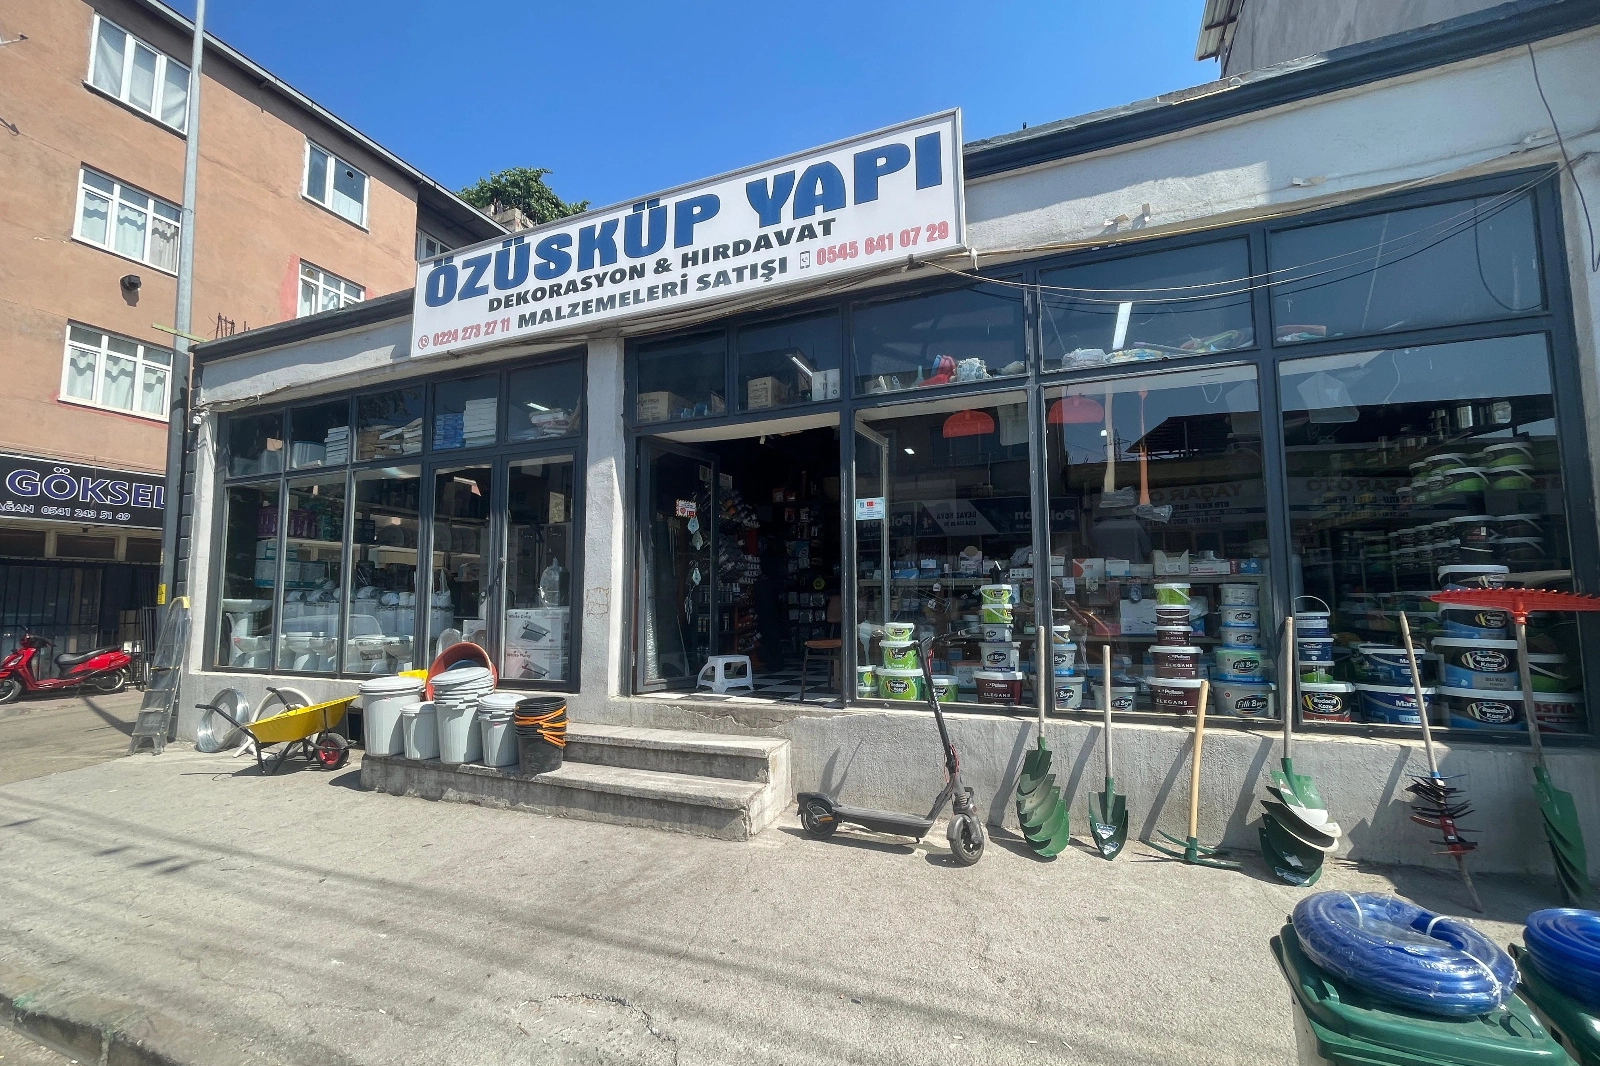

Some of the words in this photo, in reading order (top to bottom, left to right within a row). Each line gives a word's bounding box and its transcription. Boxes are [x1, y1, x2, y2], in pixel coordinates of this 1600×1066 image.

[425, 193, 721, 307] ÖZÜSKÜP
[745, 131, 943, 229] YAPI
[488, 264, 646, 312] DEKORASYON
[653, 257, 673, 275] &
[681, 217, 836, 269] HIRDAVAT
[816, 240, 859, 265] 0545
[864, 232, 894, 255] 641
[900, 226, 921, 247] 07
[926, 221, 949, 242] 29
[517, 276, 688, 329] MALZEMELERİ
[696, 256, 789, 292] SATIŞI
[433, 329, 459, 346] 0224
[461, 324, 481, 340] 273
[484, 320, 497, 336] 27
[500, 317, 511, 332] 11
[6, 467, 165, 509] GÖKSEL
[41, 506, 70, 517] 0541
[100, 511, 112, 519] 51
[1237, 700, 1251, 709] Filli
[1251, 699, 1267, 709] Boya
